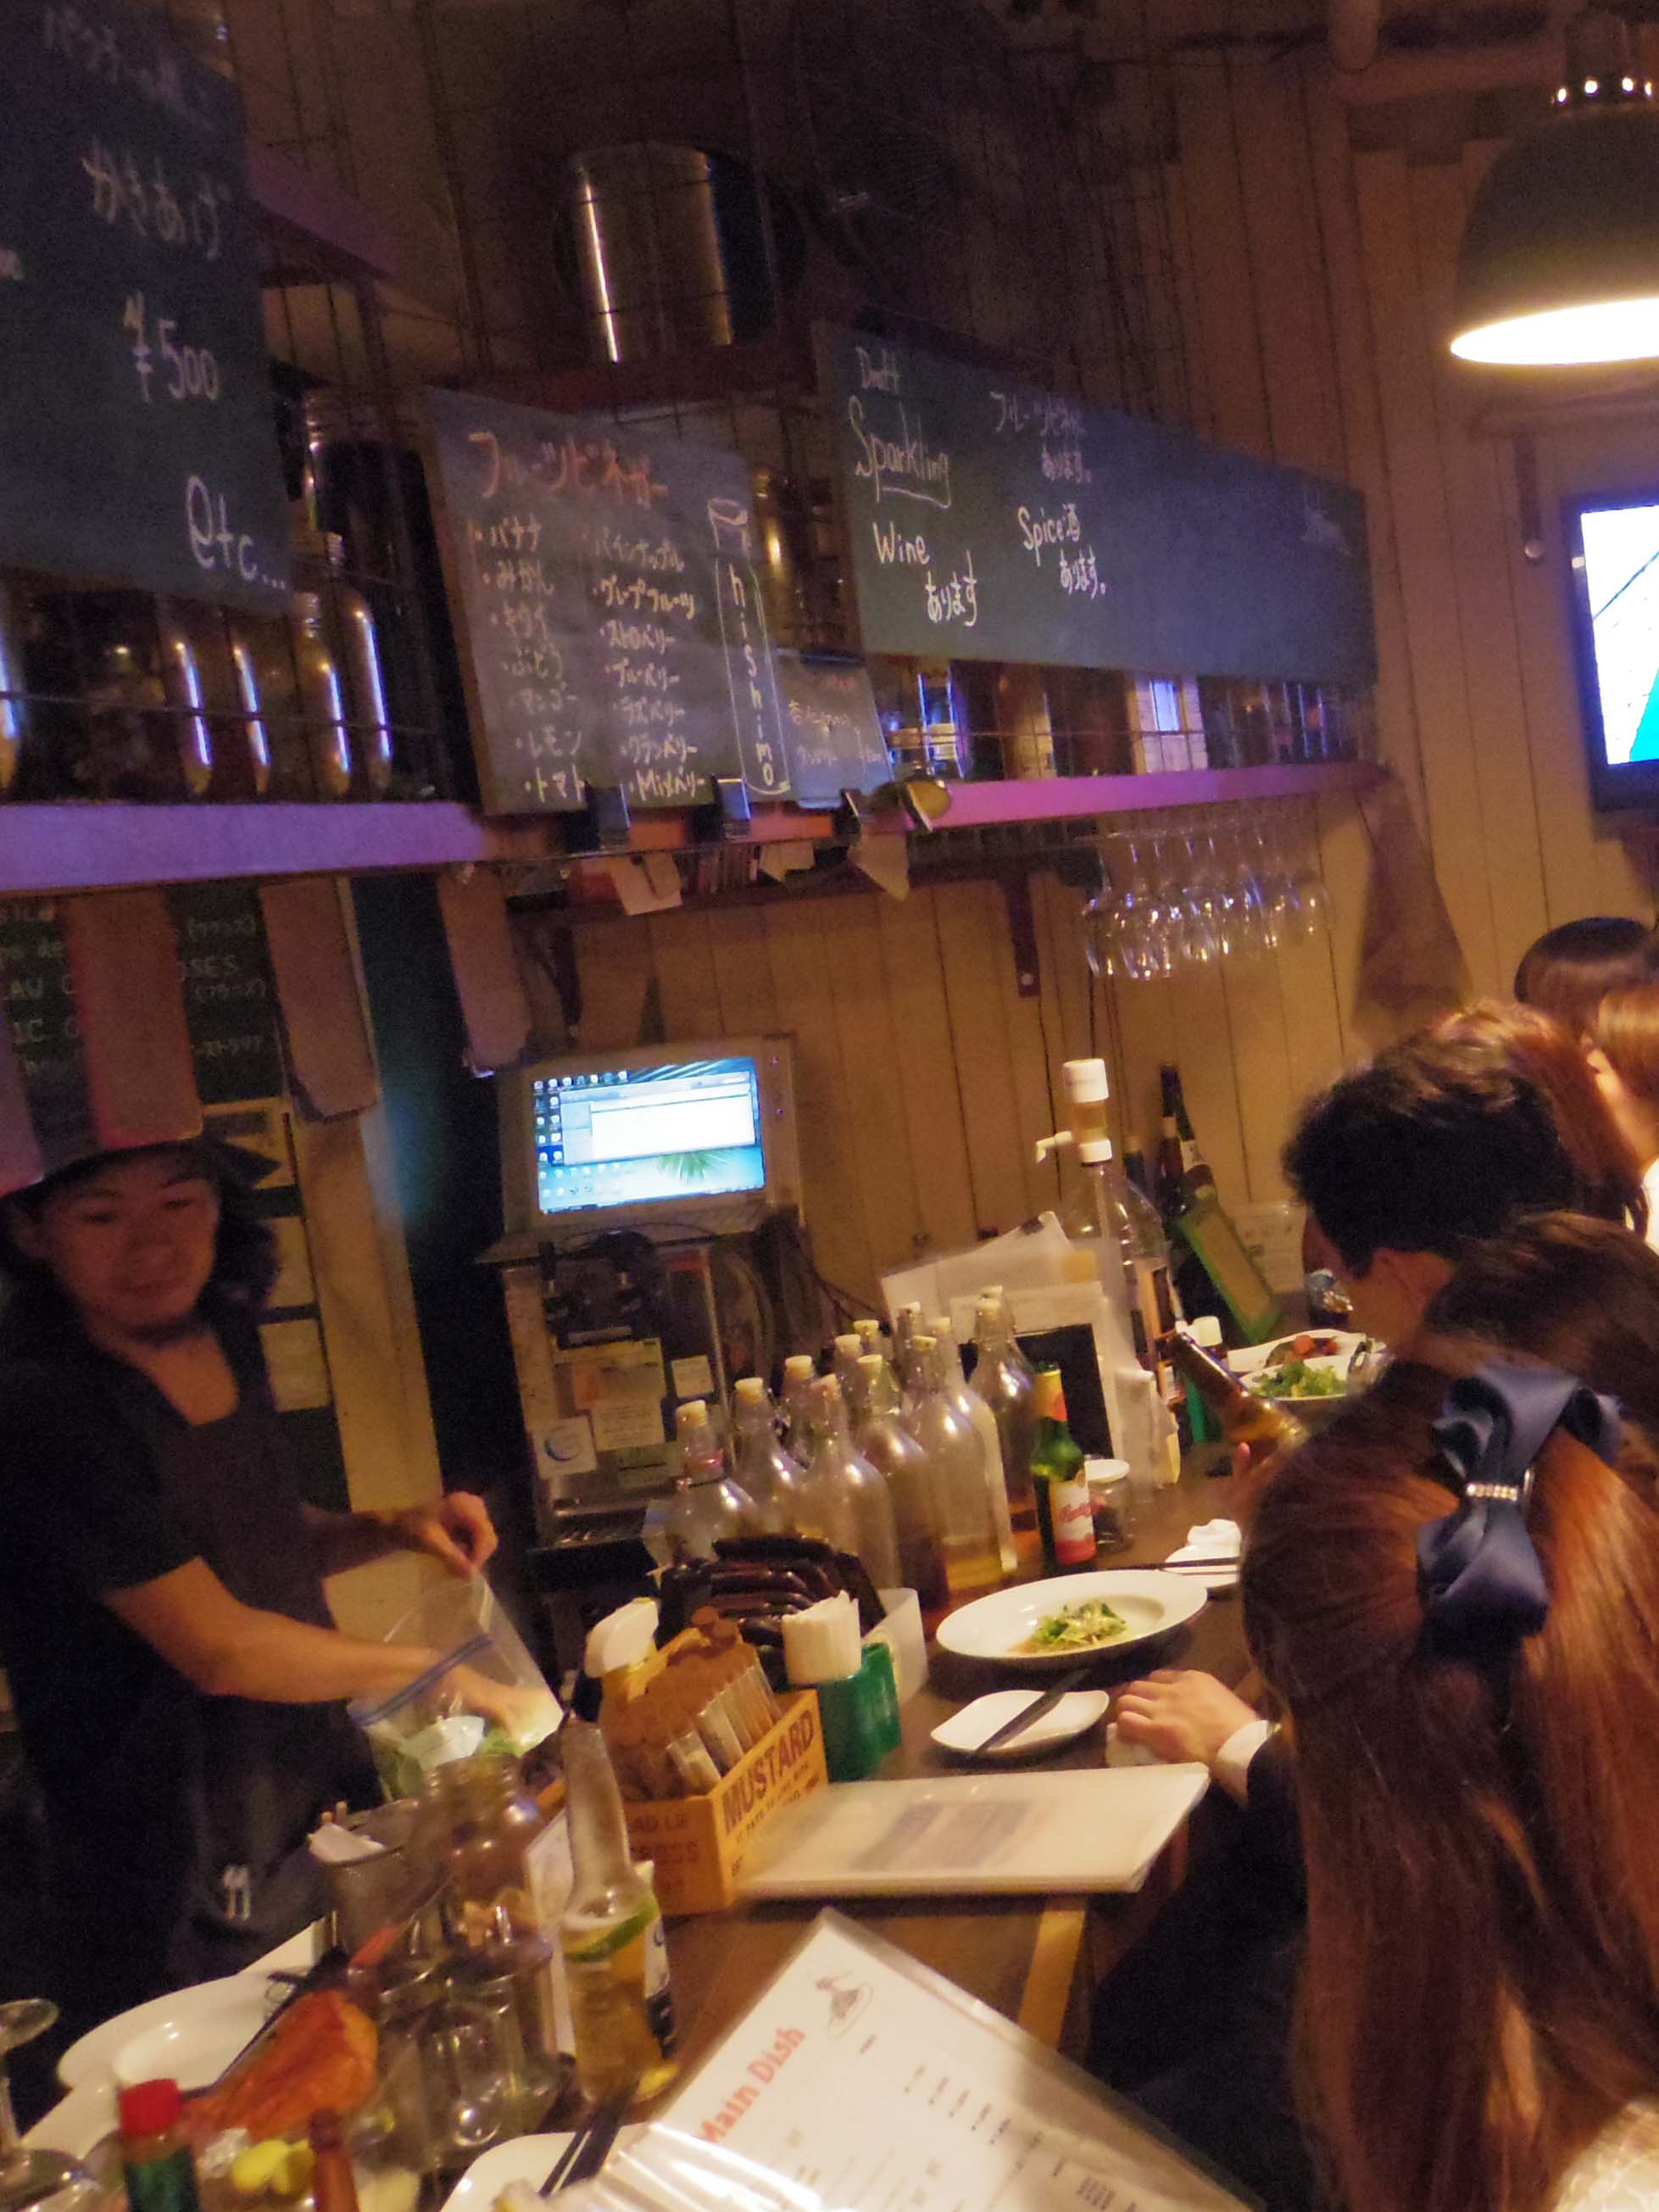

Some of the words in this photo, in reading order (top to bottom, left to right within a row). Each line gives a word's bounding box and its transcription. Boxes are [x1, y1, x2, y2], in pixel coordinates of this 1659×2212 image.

[848, 395, 951, 509] Sparkling
[872, 521, 930, 565] Wine
[925, 549, 977, 627] あります
[722, 1710, 814, 1834] MUSTARD
[746, 2027, 805, 2084] Dish
